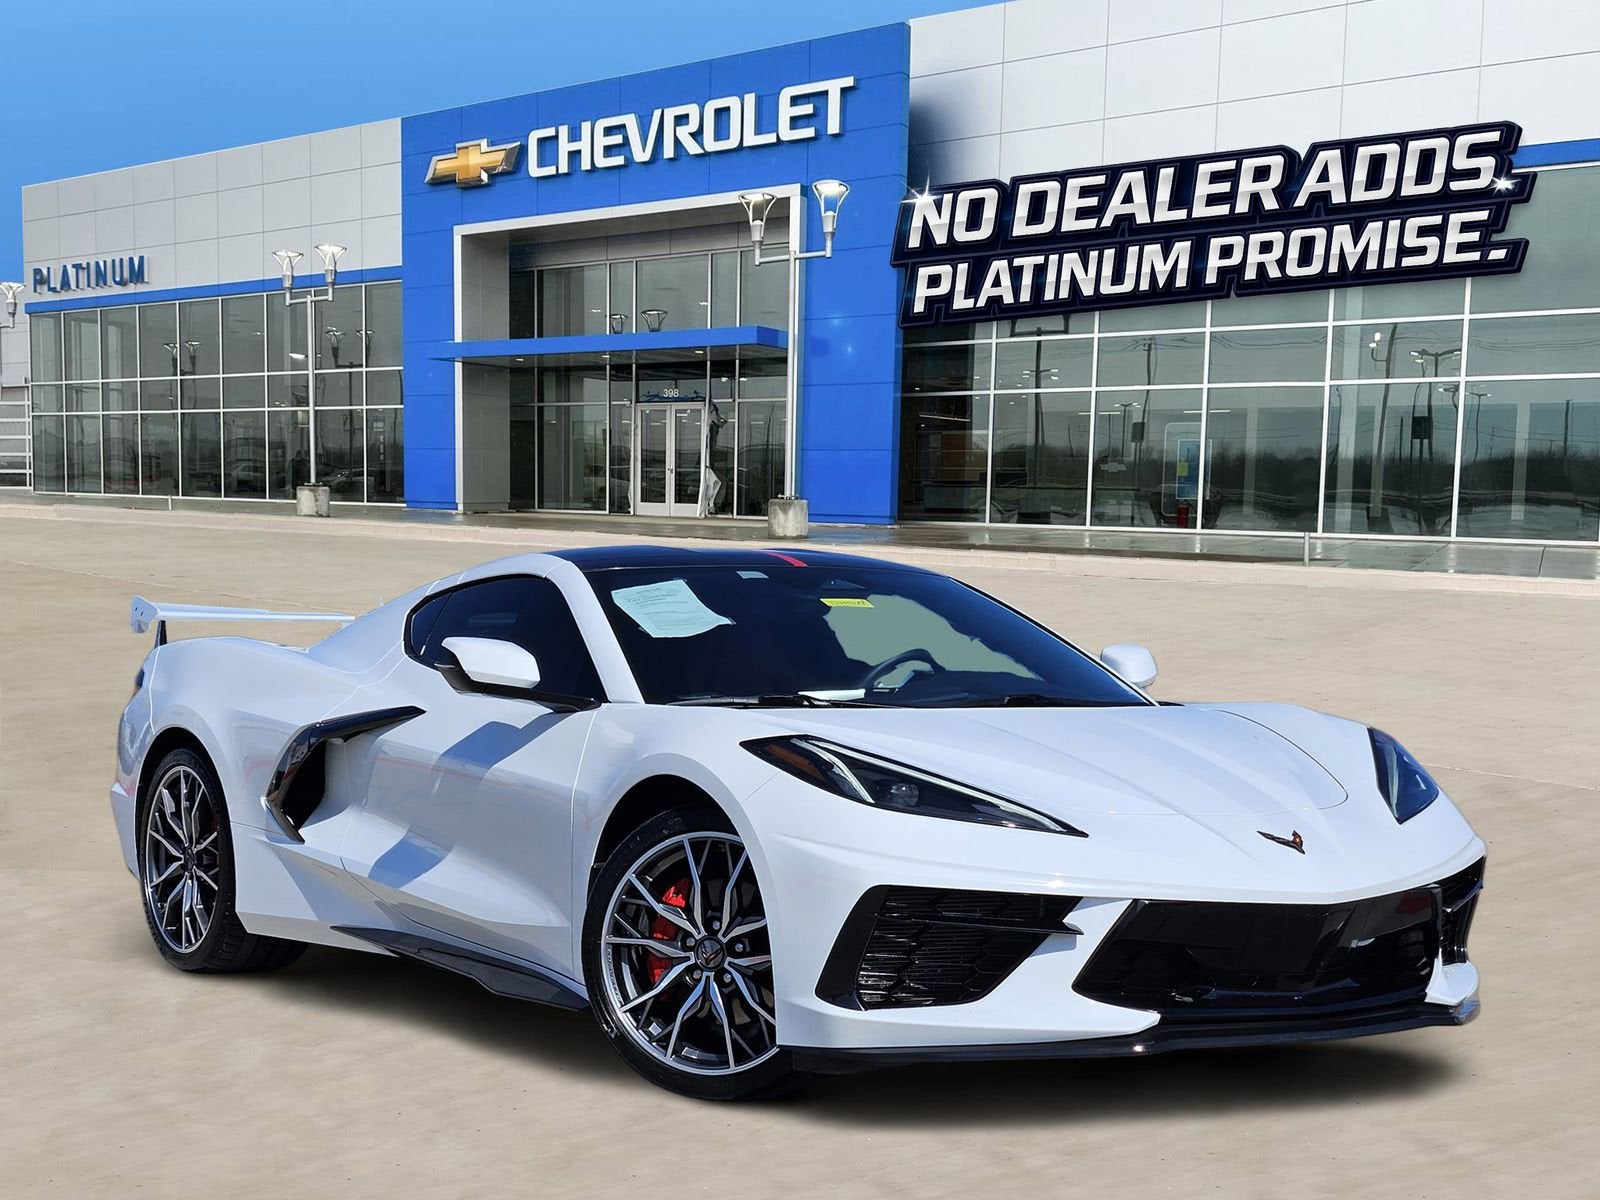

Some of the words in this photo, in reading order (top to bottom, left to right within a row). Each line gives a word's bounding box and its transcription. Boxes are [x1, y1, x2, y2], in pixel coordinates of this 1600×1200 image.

[528, 76, 855, 178] CHEVROLET
[33, 255, 145, 293] PLATINUM
[663, 388, 680, 398] 398
